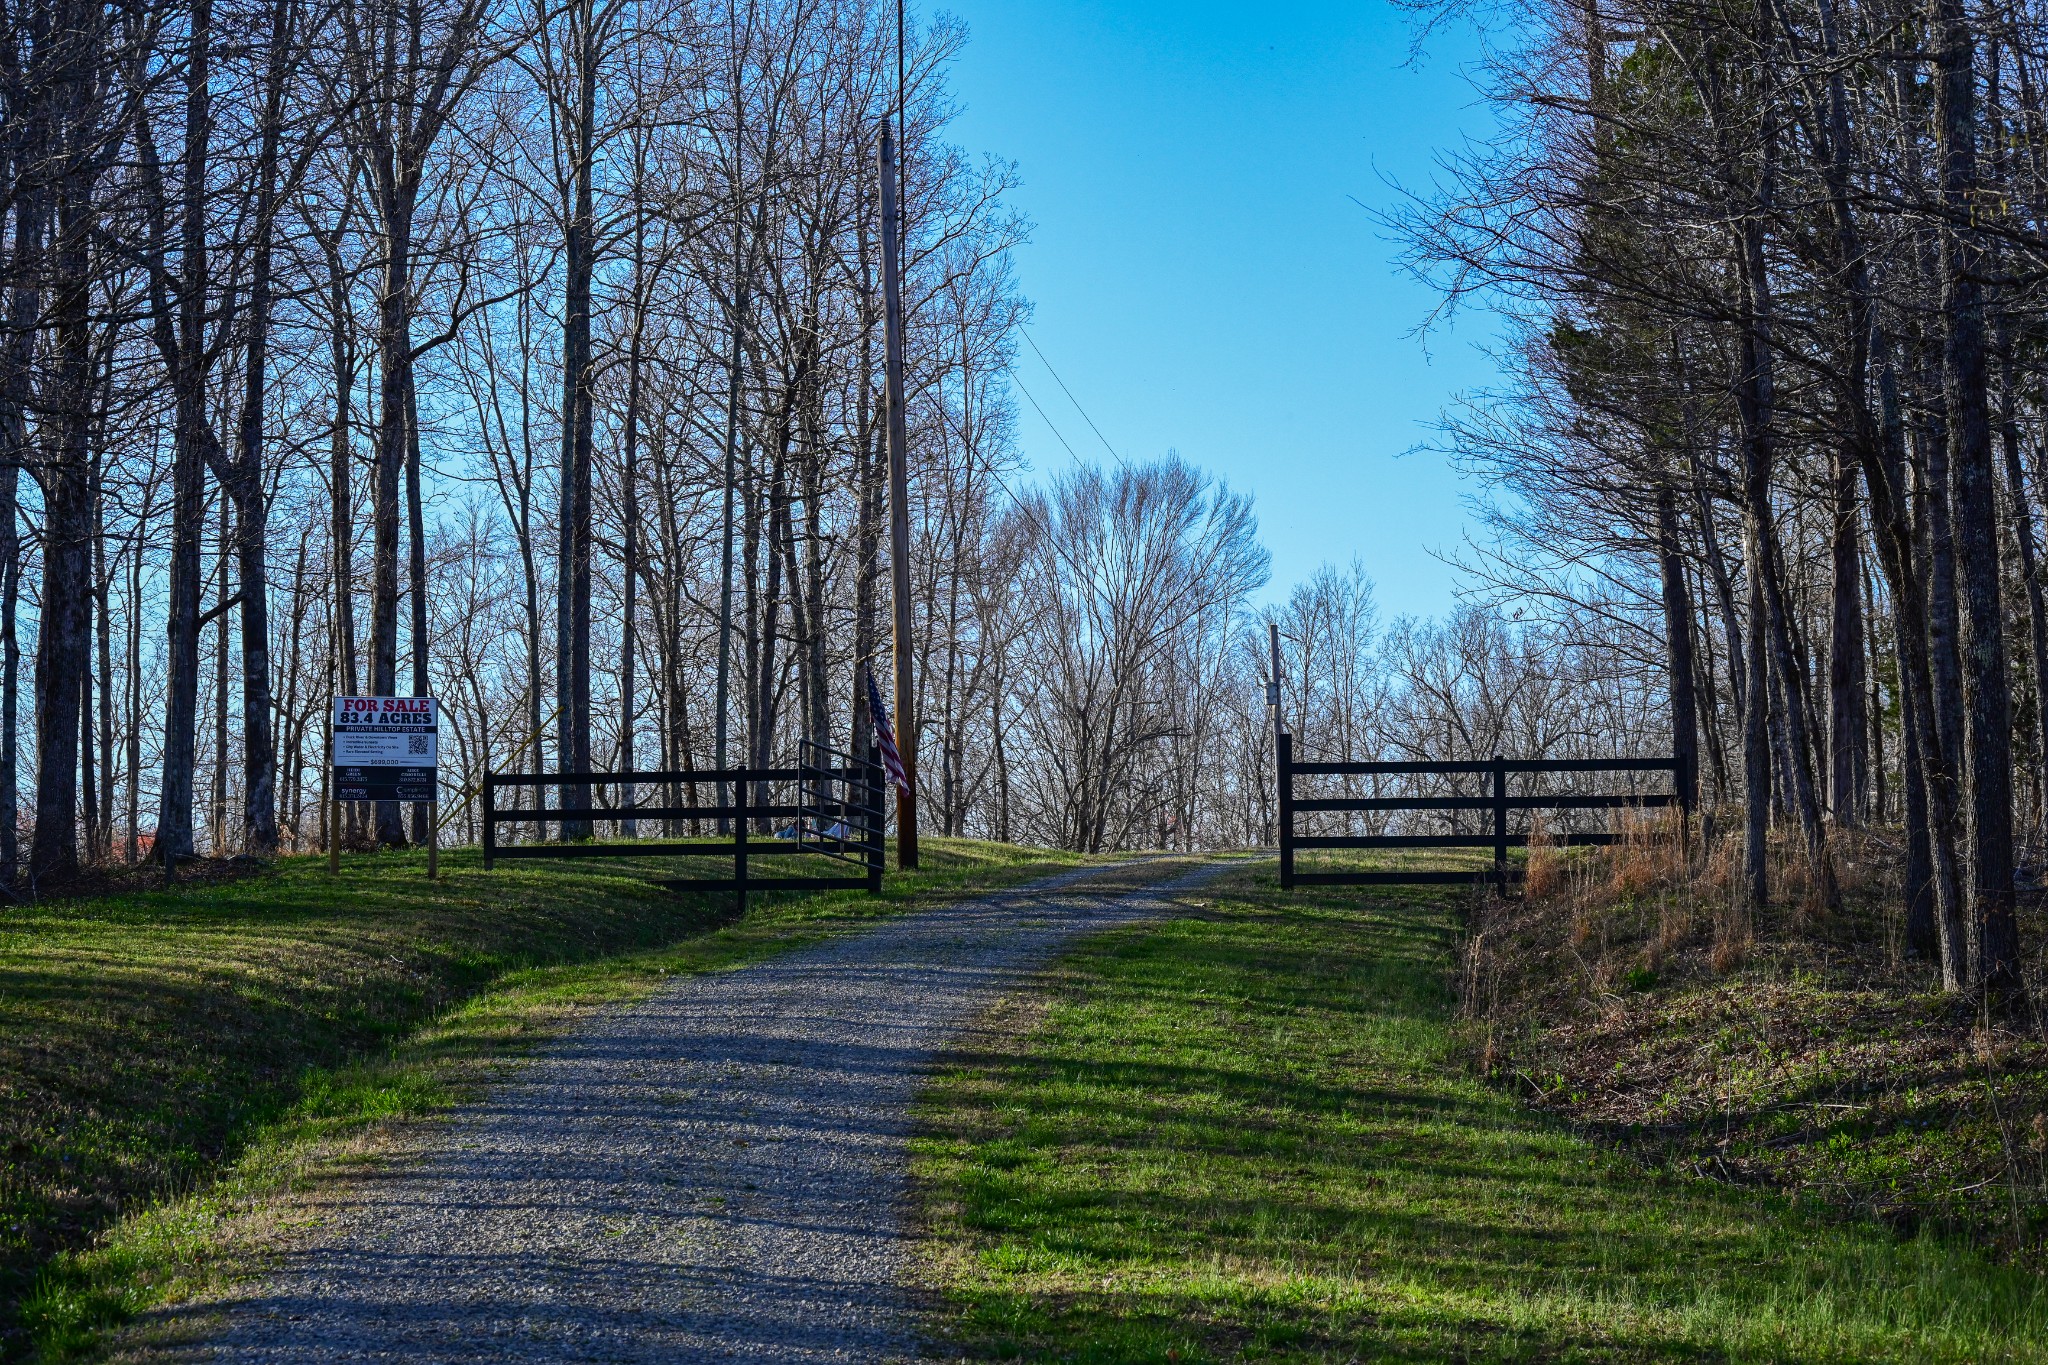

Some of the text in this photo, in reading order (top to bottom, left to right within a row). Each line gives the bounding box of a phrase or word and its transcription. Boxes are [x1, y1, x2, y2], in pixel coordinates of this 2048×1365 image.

[344, 699, 430, 712] FOR SALE
[340, 712, 432, 724] 83.4 ACRES
